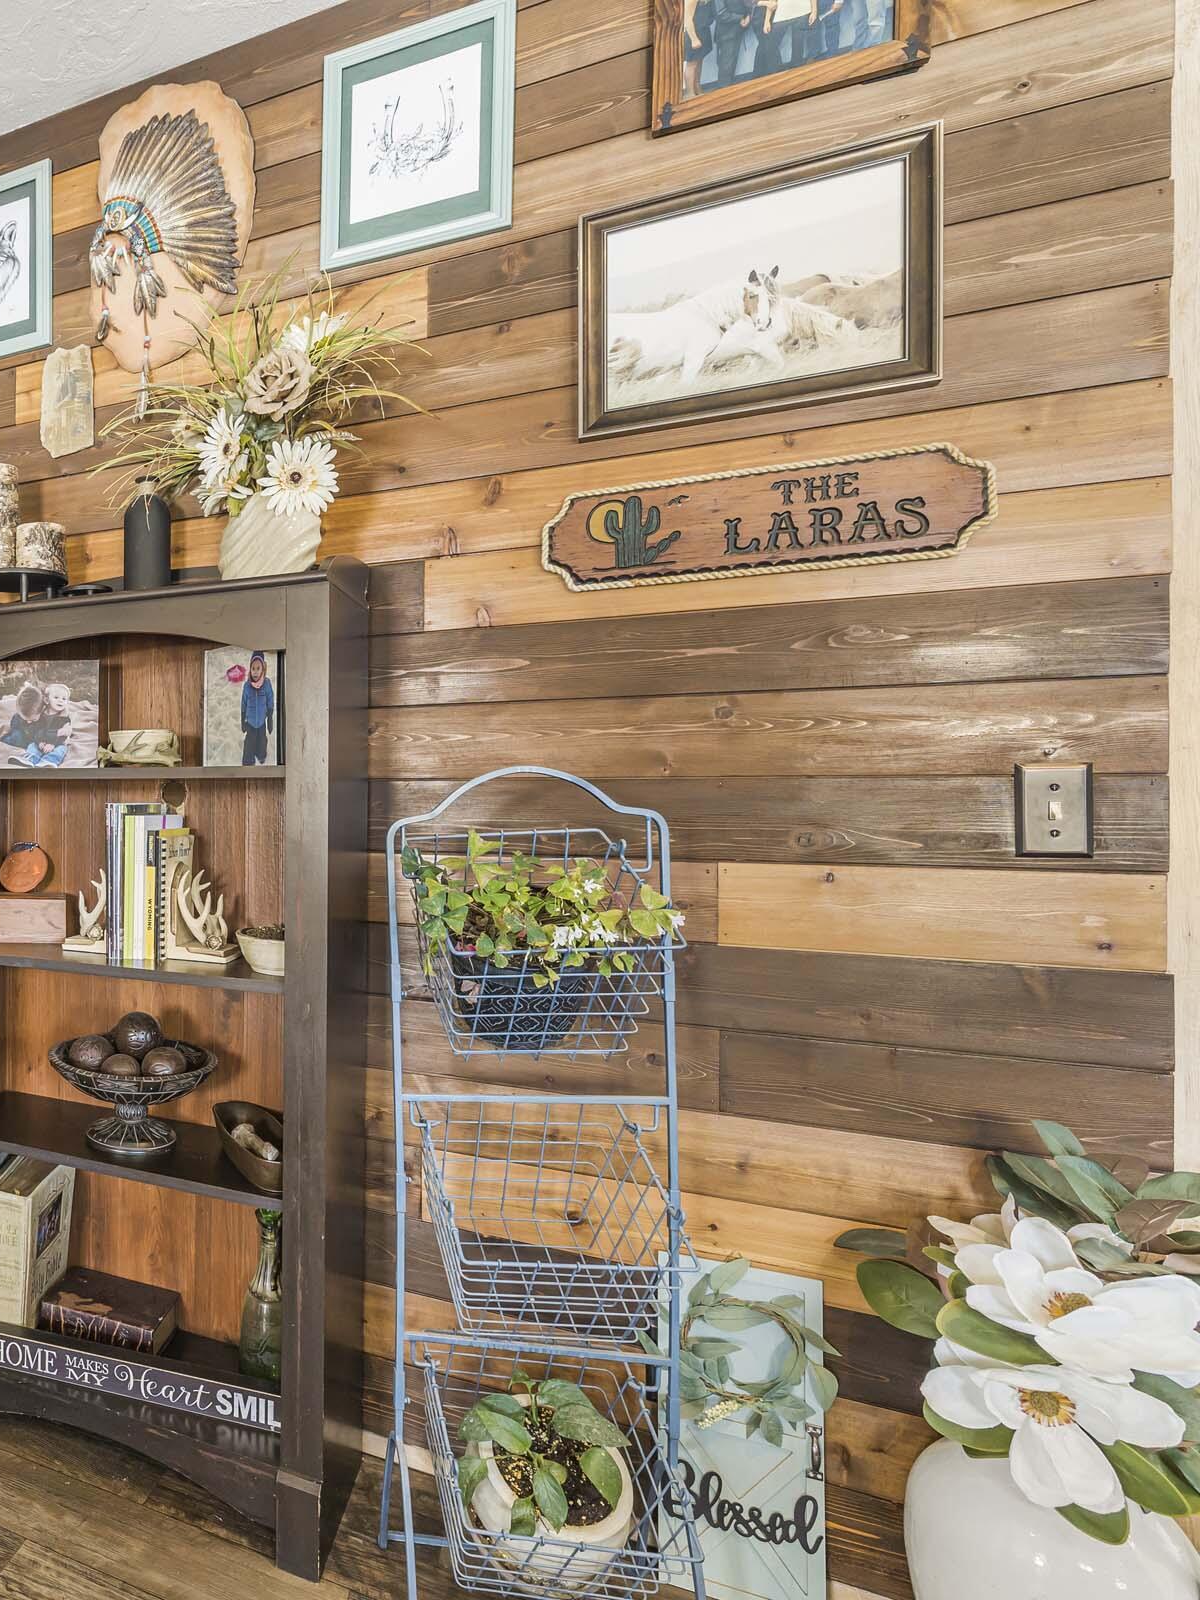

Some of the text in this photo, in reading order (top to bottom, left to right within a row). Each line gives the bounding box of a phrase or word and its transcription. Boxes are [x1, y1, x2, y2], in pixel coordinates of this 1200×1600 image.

[771, 472, 859, 506] THE
[723, 497, 930, 556] LARAS
[65, 1355, 109, 1375] MAKES
[65, 1368, 109, 1387] MY
[114, 1363, 213, 1411] Heart
[215, 1388, 281, 1427] SMIL
